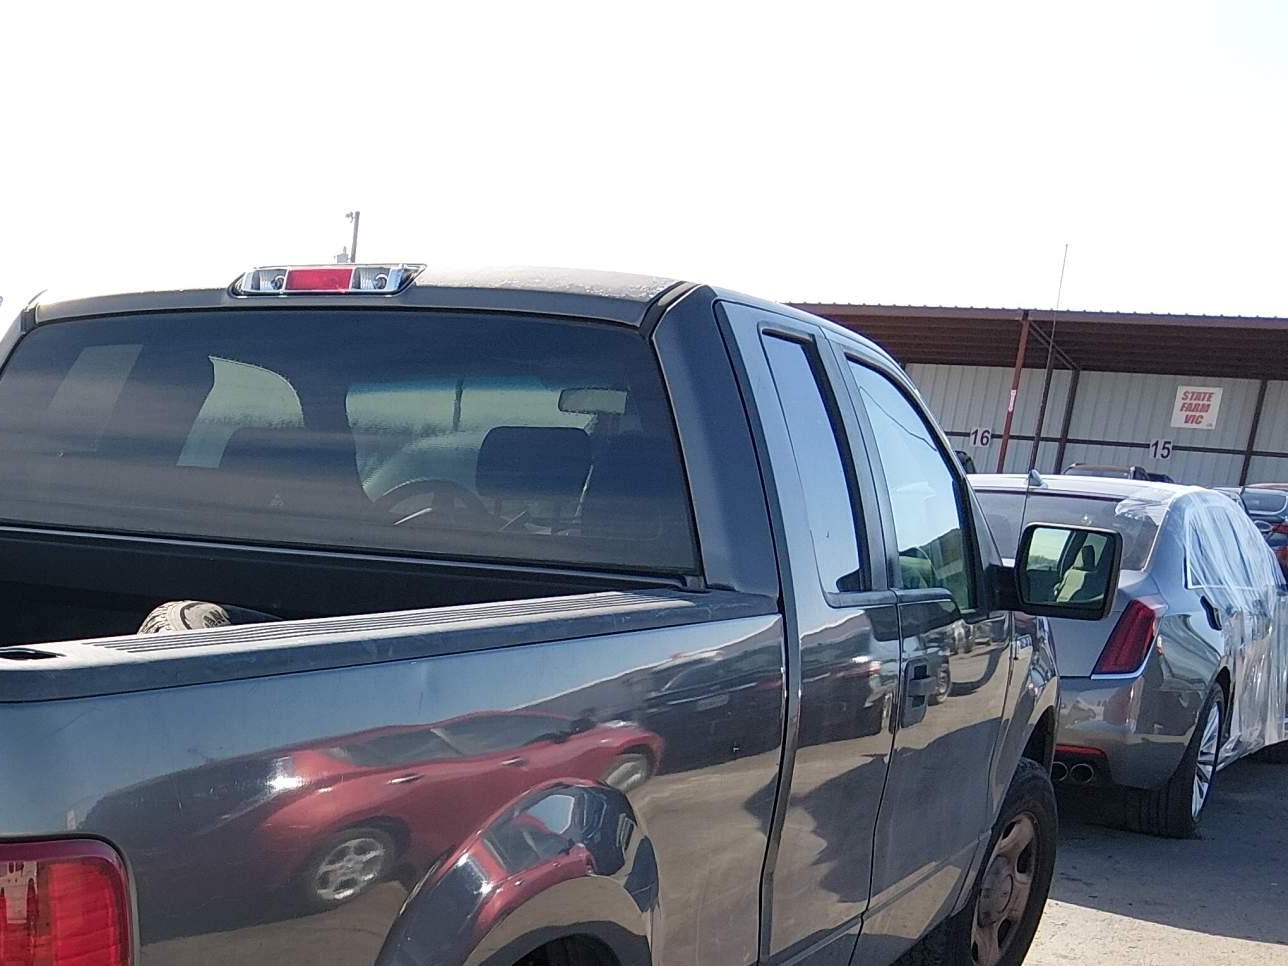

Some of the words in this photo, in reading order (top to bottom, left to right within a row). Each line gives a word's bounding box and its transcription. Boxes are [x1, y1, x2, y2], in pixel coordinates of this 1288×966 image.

[1181, 391, 1214, 402] STATE
[1180, 402, 1210, 413] FARM
[1184, 414, 1203, 424] VIC
[971, 429, 990, 446] 16
[1152, 440, 1172, 459] 15
